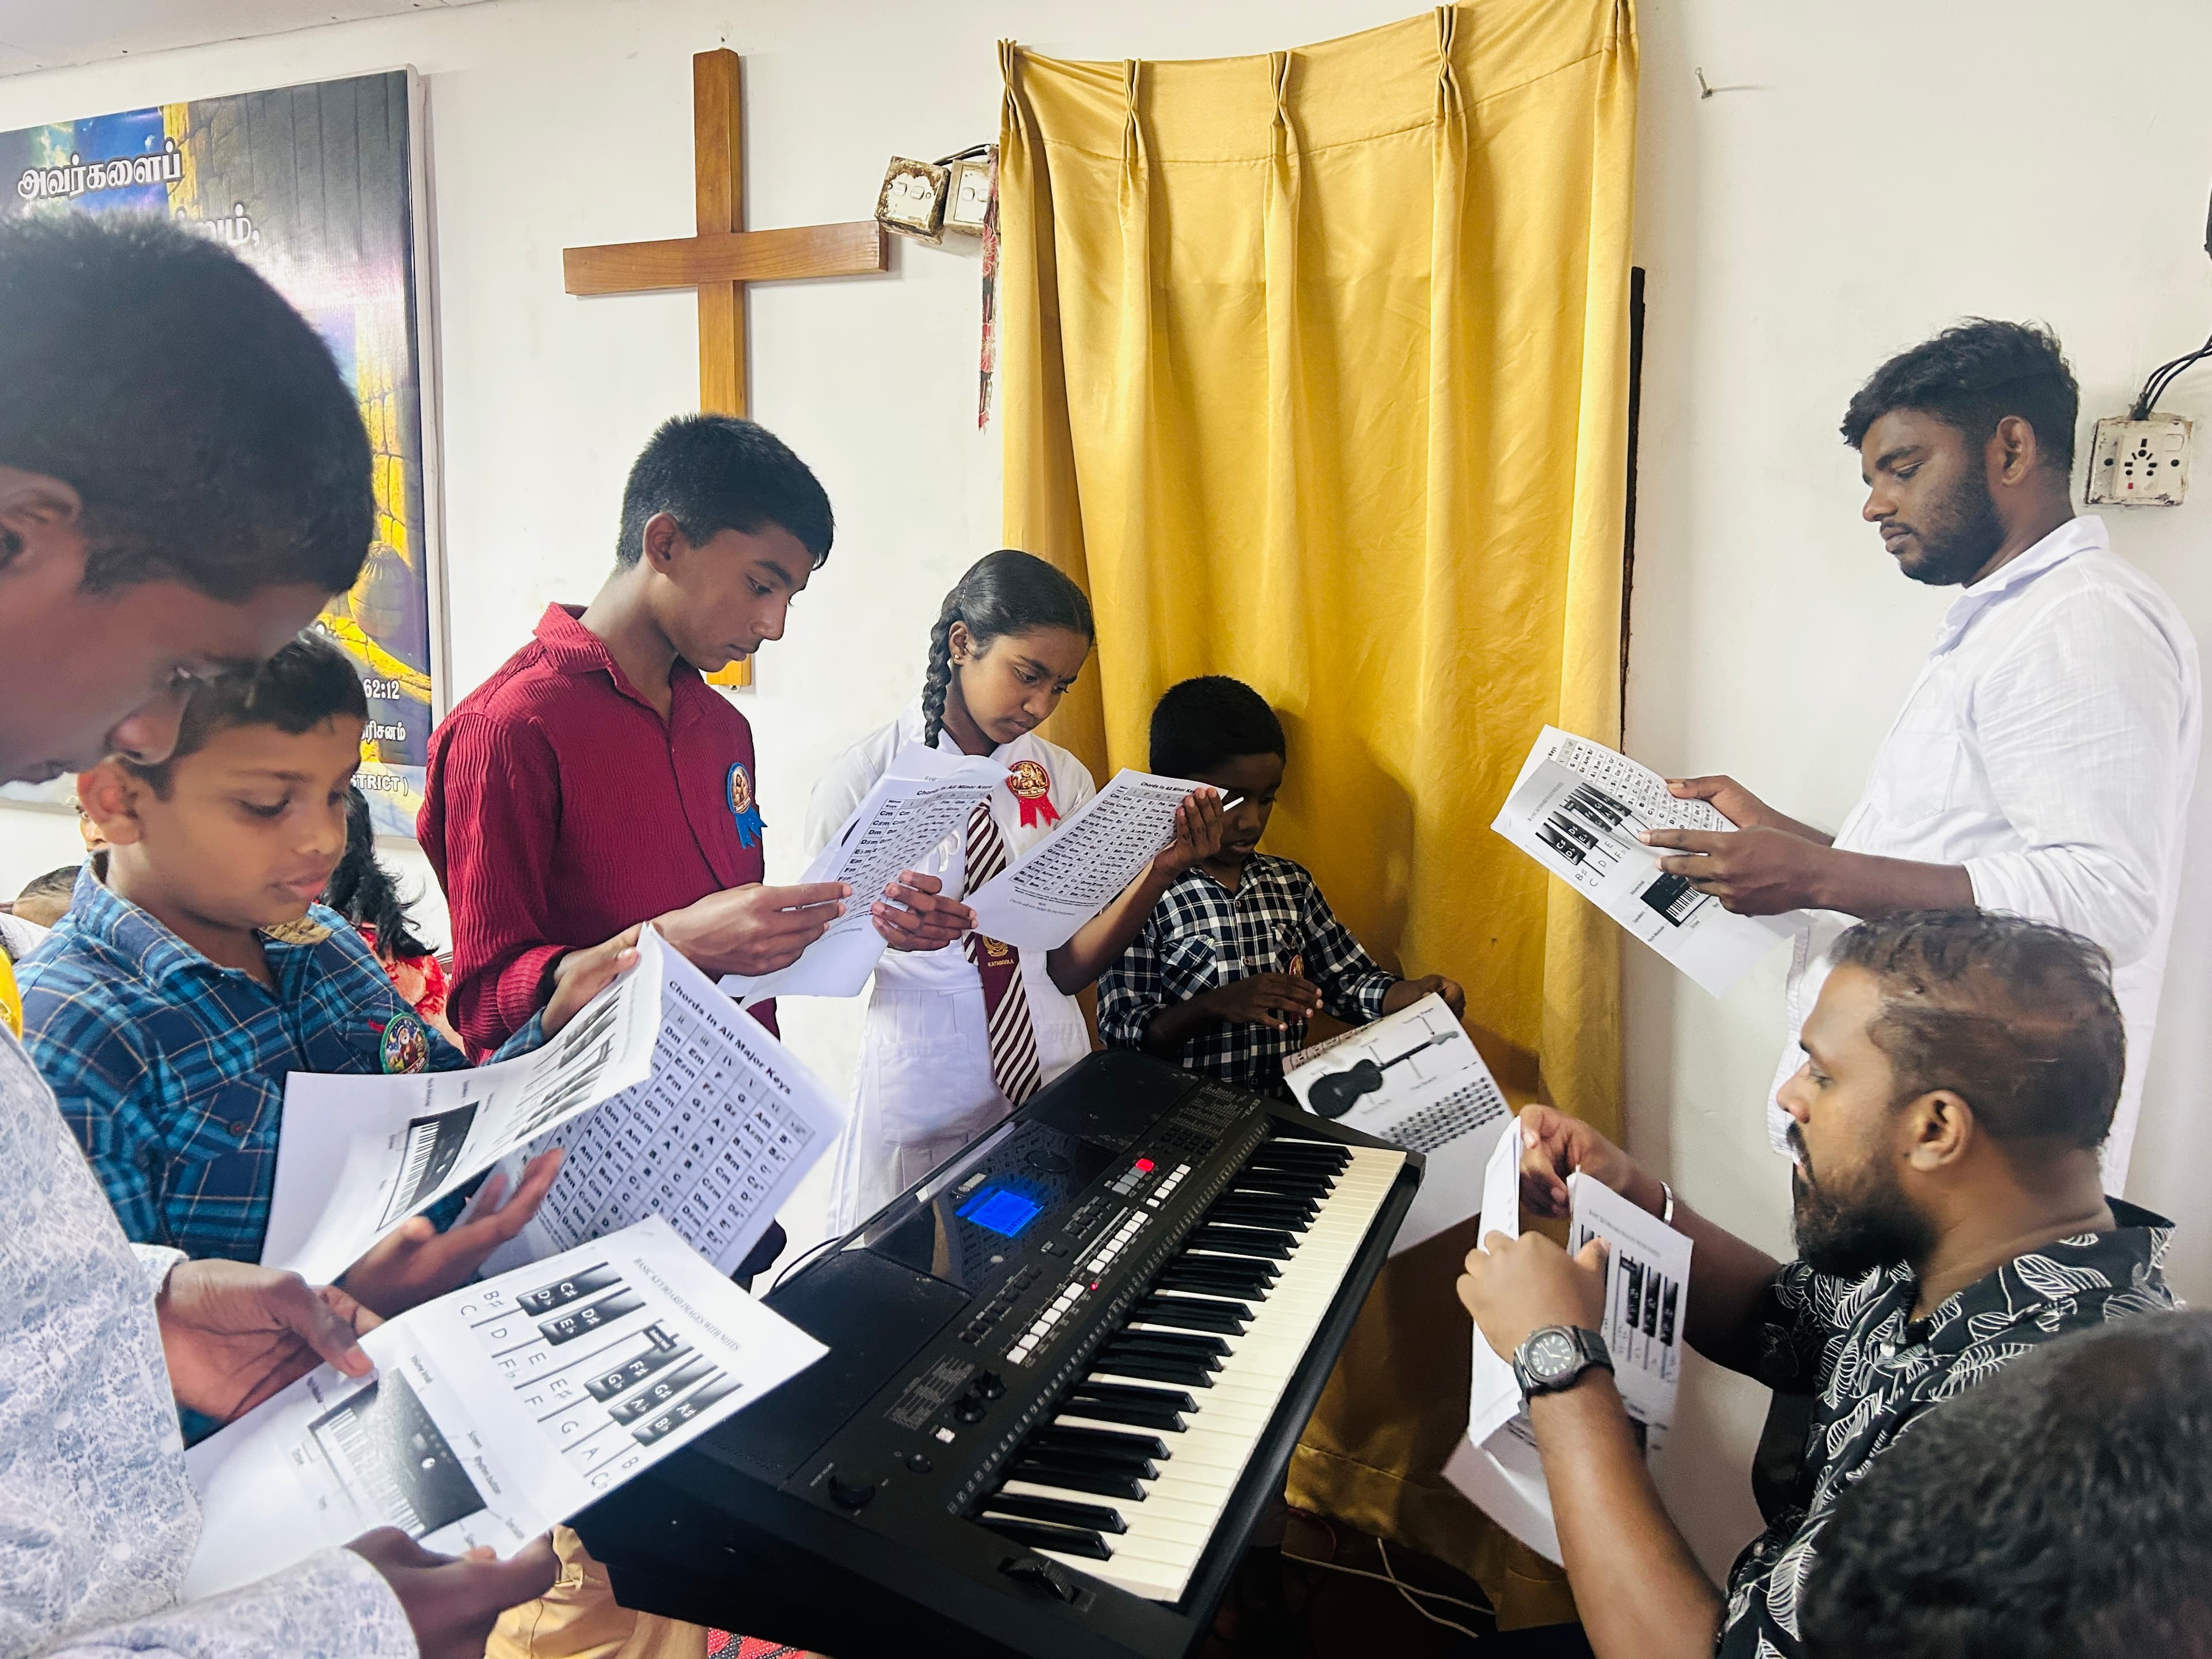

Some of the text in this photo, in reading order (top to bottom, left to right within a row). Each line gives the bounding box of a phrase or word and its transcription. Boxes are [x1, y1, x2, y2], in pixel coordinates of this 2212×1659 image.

[17, 138, 181, 199] அவர்களைப்
[460, 1304, 478, 1316] C
[524, 1395, 544, 1405] F
[490, 1327, 507, 1339] D
[528, 1351, 547, 1365] E
[560, 1420, 579, 1434] G
[581, 1446, 600, 1460] A
[621, 1456, 639, 1469] B
